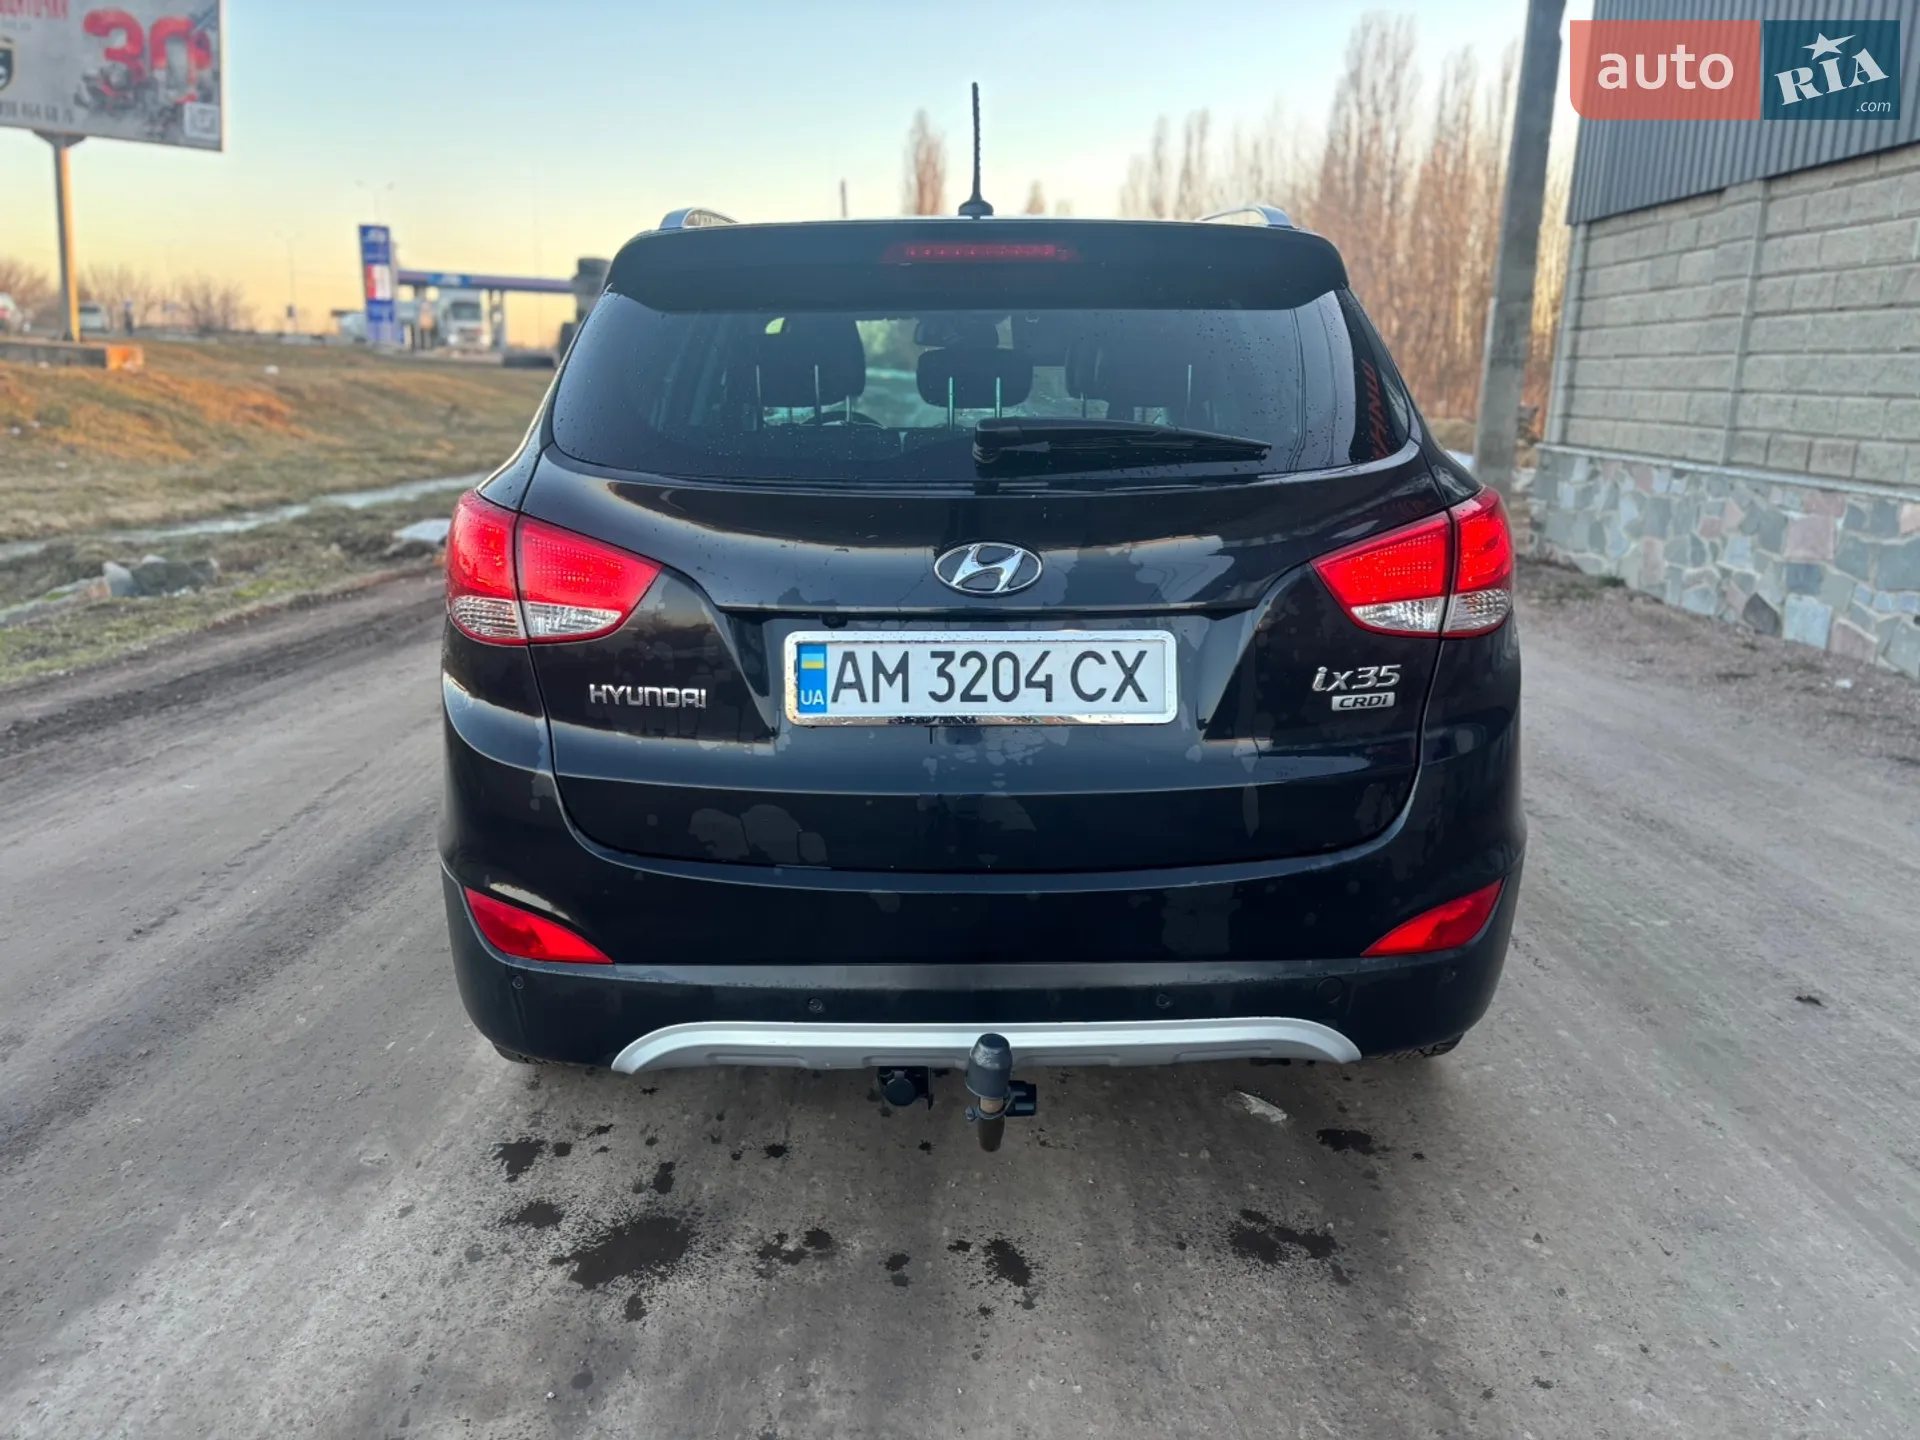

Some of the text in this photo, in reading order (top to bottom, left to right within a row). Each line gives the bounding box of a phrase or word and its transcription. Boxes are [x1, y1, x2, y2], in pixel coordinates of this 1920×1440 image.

[831, 650, 1148, 703] AM 3204 CX
[1312, 664, 1402, 692] ix35
[589, 684, 707, 708] HYUNDAI
[800, 689, 825, 706] UA
[1338, 694, 1390, 708] CRDi
